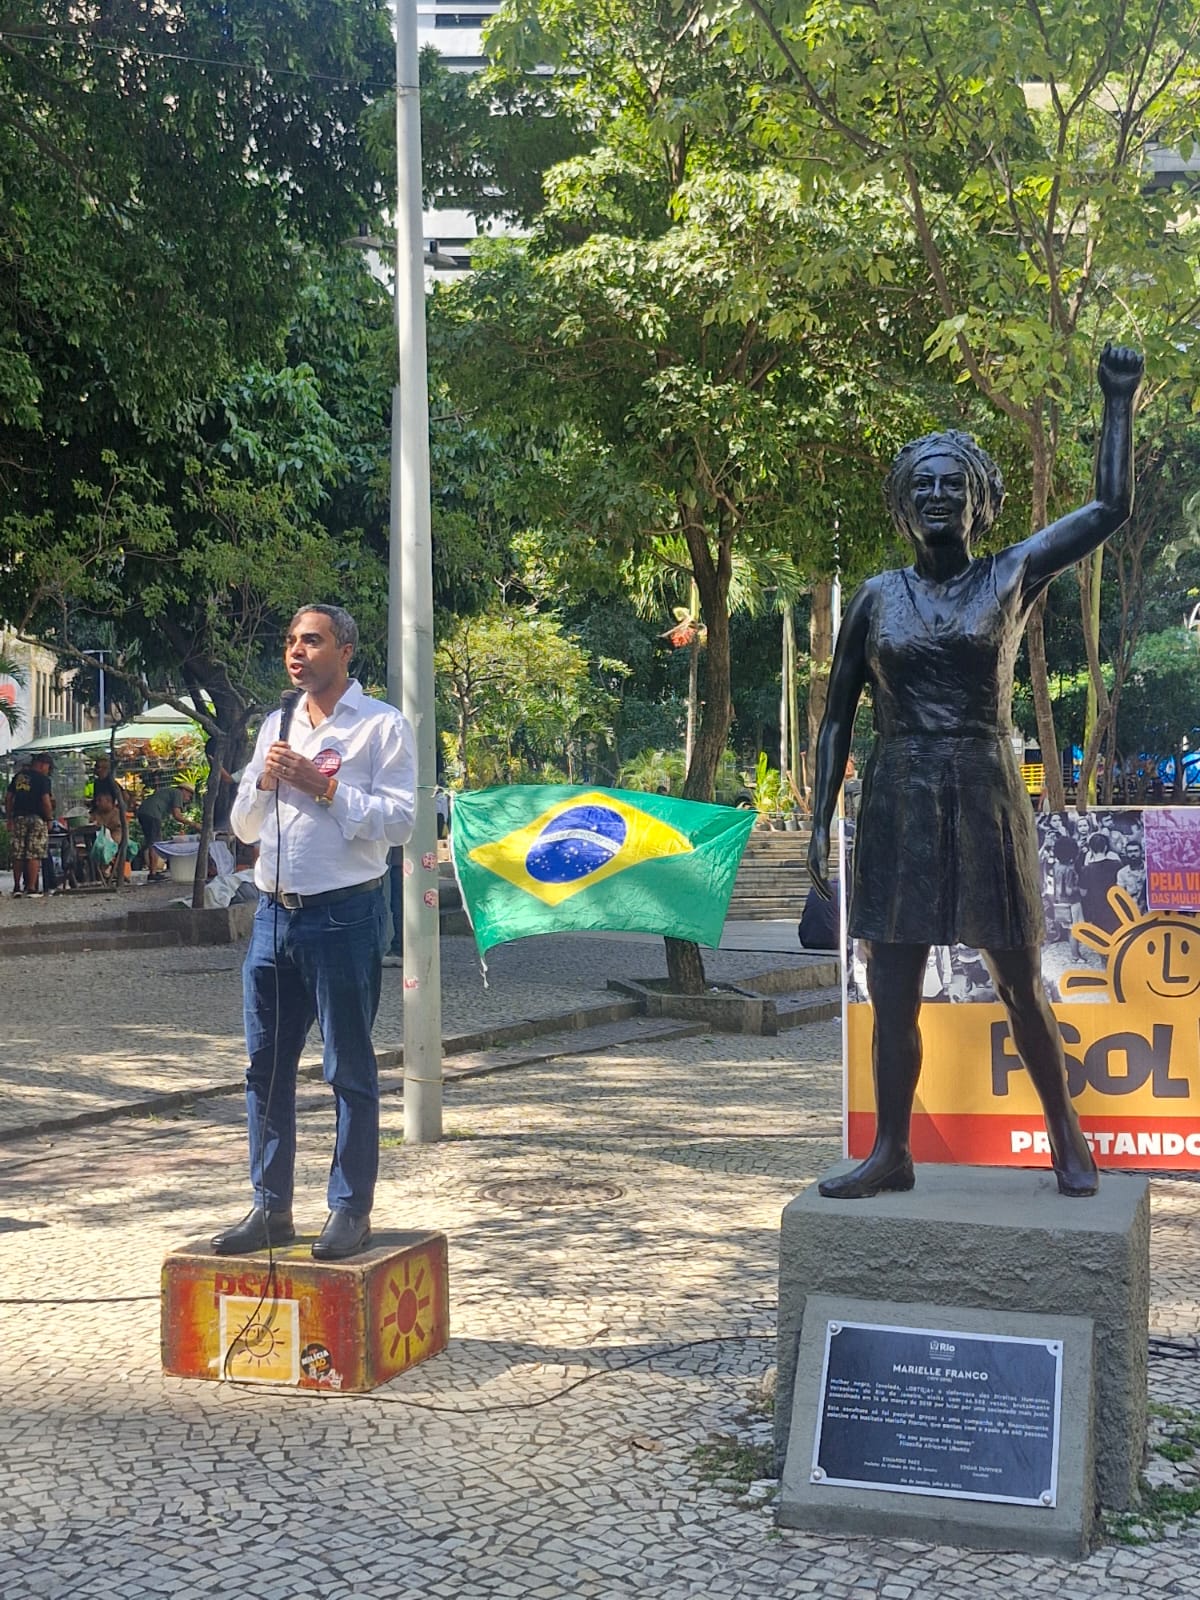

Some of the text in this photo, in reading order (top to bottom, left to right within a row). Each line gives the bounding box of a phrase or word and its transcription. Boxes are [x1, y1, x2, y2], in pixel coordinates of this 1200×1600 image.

[1151, 872, 1184, 891] PELA
[1152, 893, 1169, 904] DAS
[1011, 1131, 1200, 1155] PRSTANDO
[939, 1342, 956, 1352] Rio
[892, 1363, 989, 1381] MARIELLE FRANCO
